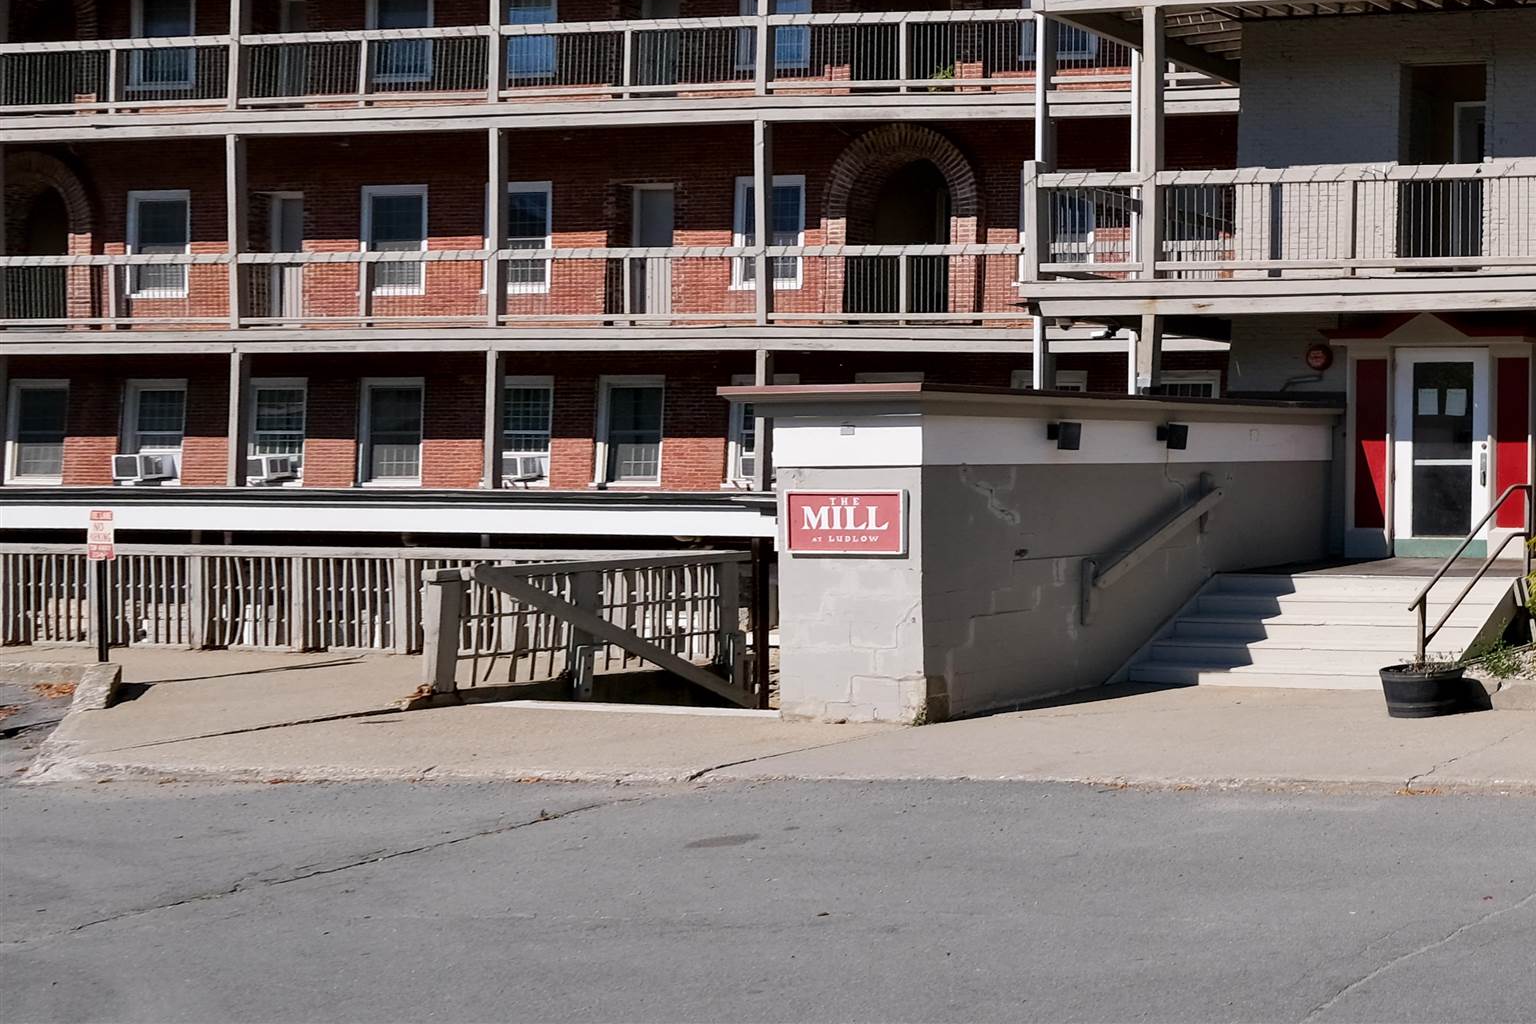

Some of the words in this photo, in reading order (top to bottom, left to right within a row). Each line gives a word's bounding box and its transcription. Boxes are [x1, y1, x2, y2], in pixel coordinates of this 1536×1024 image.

[829, 497, 861, 506] THE
[801, 505, 889, 530] MILL
[828, 535, 880, 543] LUDLOW
